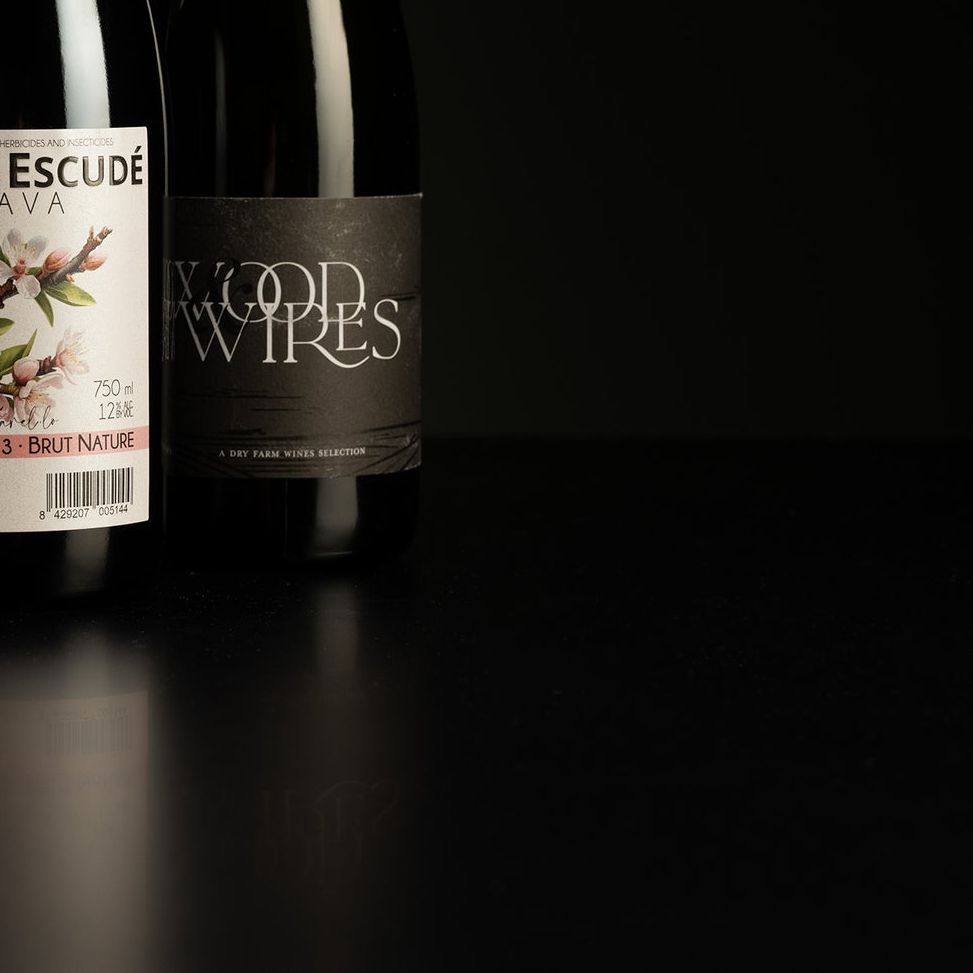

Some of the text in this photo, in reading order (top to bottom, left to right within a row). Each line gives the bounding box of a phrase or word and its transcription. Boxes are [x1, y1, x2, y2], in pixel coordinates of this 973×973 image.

[0, 138, 45, 148] HERBICIDES
[47, 138, 65, 147] AND
[67, 137, 114, 147] INSECTICIDES
[9, 145, 143, 189] ESCUDÉ
[176, 298, 402, 369] WIRES
[93, 379, 134, 398] 750 ml
[28, 436, 73, 454] BRUT
[78, 431, 135, 452] NATURE
[219, 446, 366, 458] A DRY FARM WINES SELECTION
[39, 505, 128, 520] 8 429207 005144
